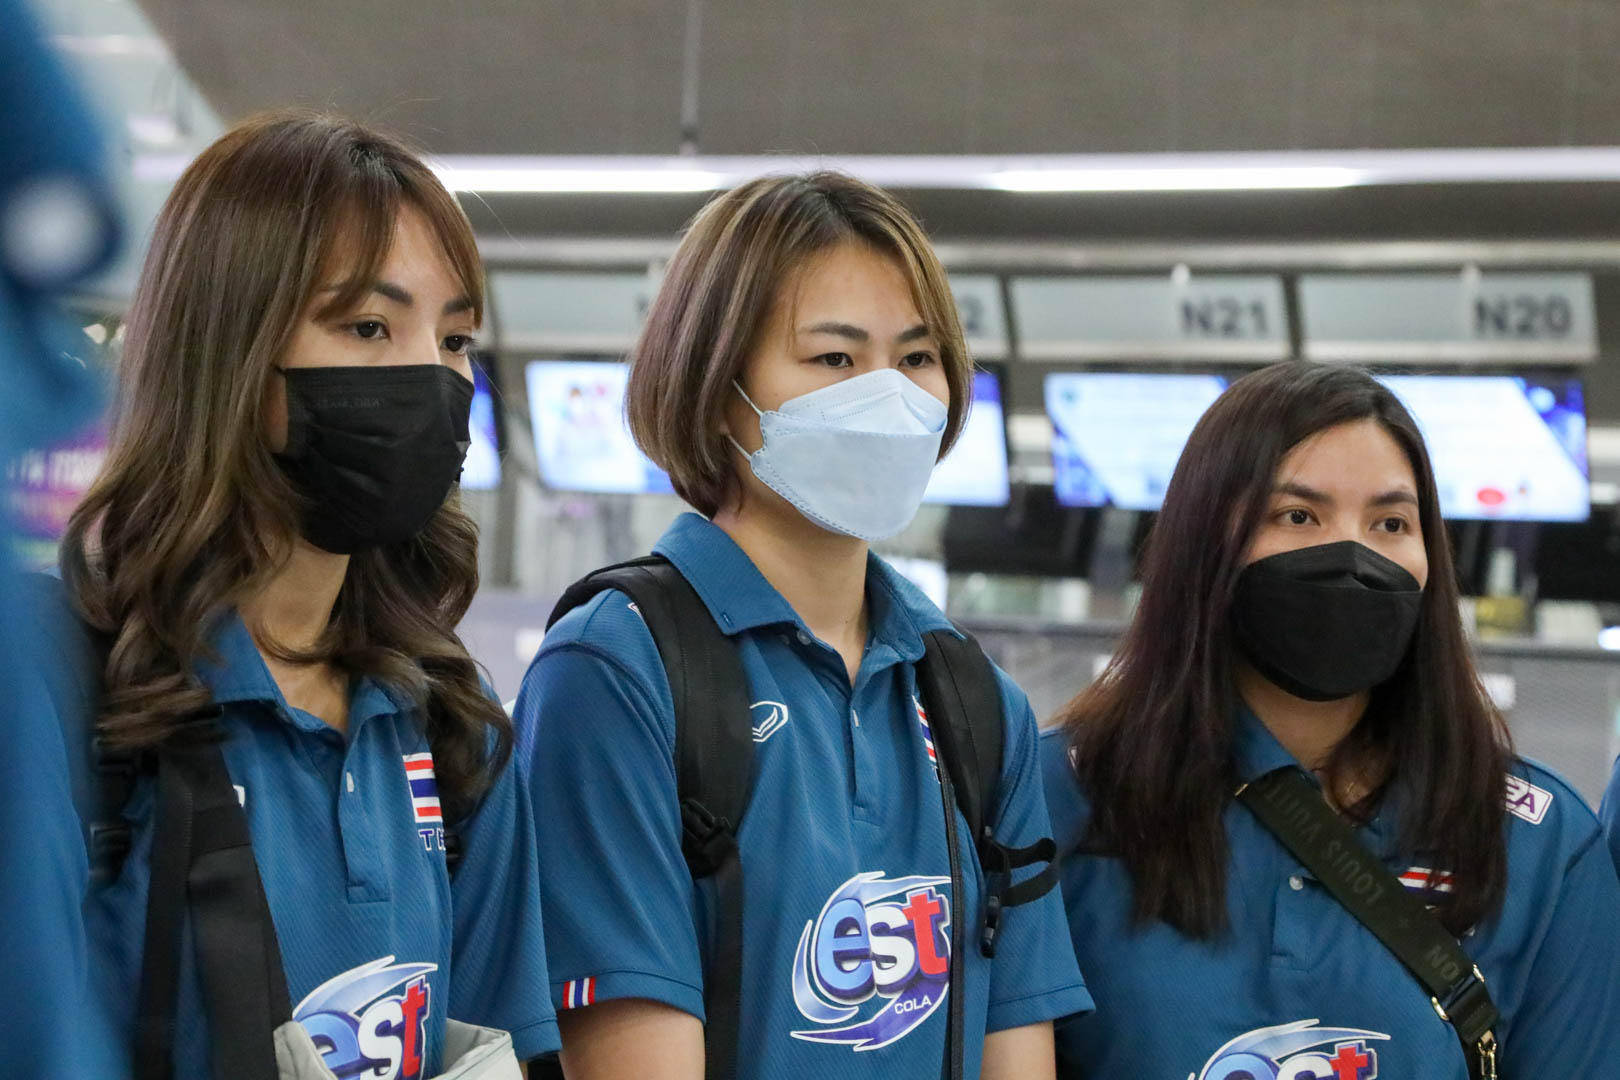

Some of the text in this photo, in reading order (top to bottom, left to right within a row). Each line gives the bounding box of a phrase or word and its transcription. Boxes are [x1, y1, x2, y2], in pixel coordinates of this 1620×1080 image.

[1181, 298, 1268, 339] N21
[1475, 294, 1572, 338] N20
[1327, 840, 1384, 904] LOUIS
[815, 888, 948, 997] est
[894, 994, 932, 1015] COLA
